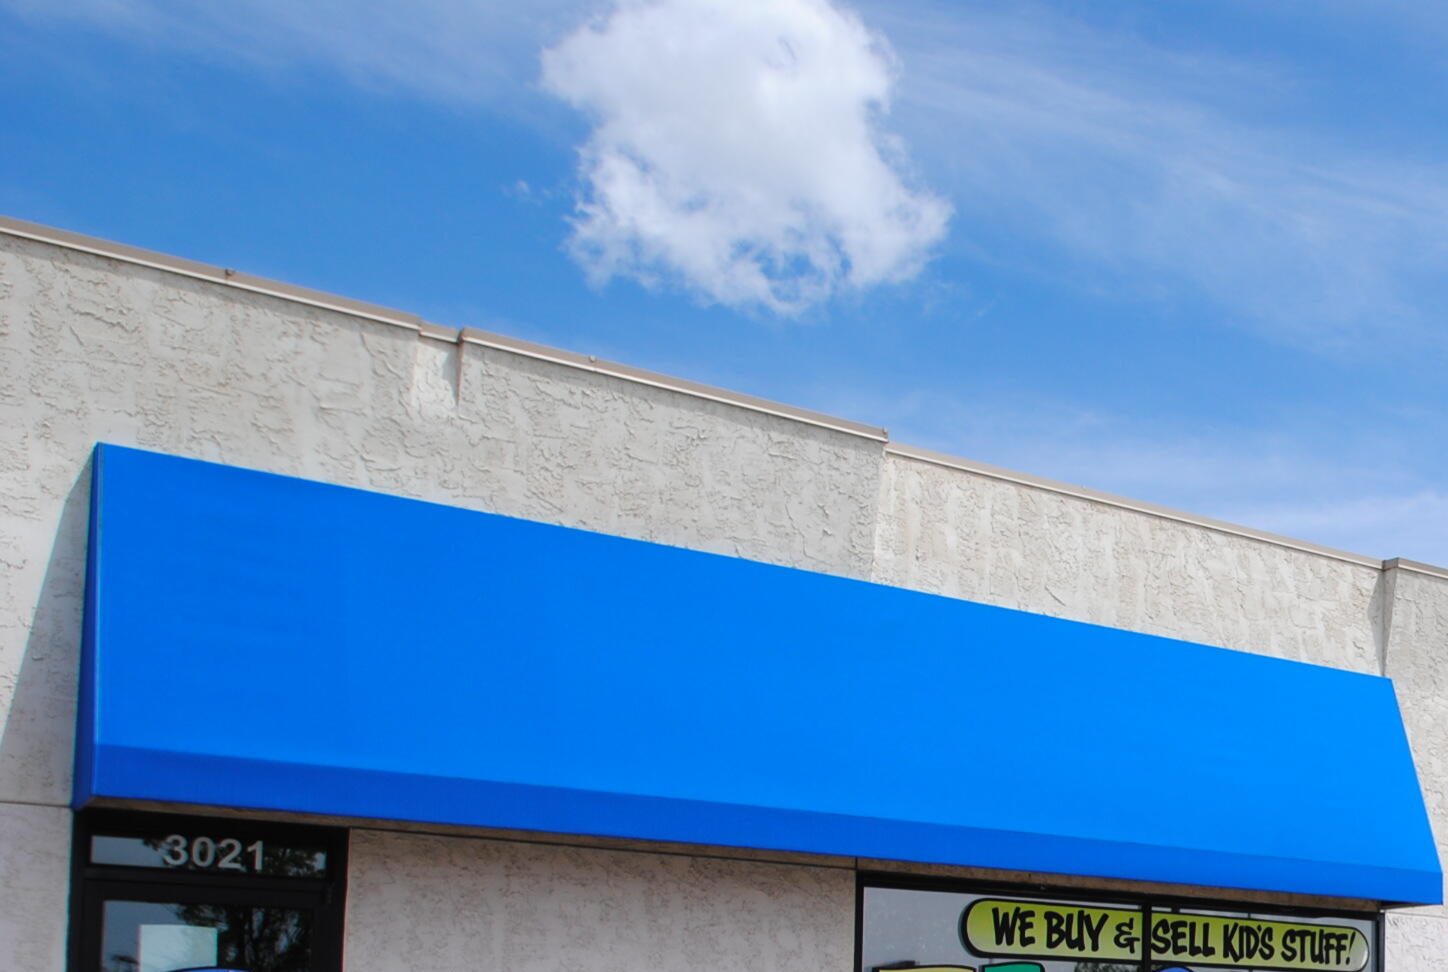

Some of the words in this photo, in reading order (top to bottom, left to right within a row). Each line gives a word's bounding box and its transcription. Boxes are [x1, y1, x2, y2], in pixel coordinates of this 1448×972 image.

[164, 834, 264, 871] 3021
[991, 906, 1036, 948] WE
[1044, 909, 1110, 953] BUY
[1113, 917, 1141, 954] &
[1151, 918, 1216, 958] SELL
[1222, 922, 1275, 963] KID'S
[1280, 928, 1356, 965] STUFF!
